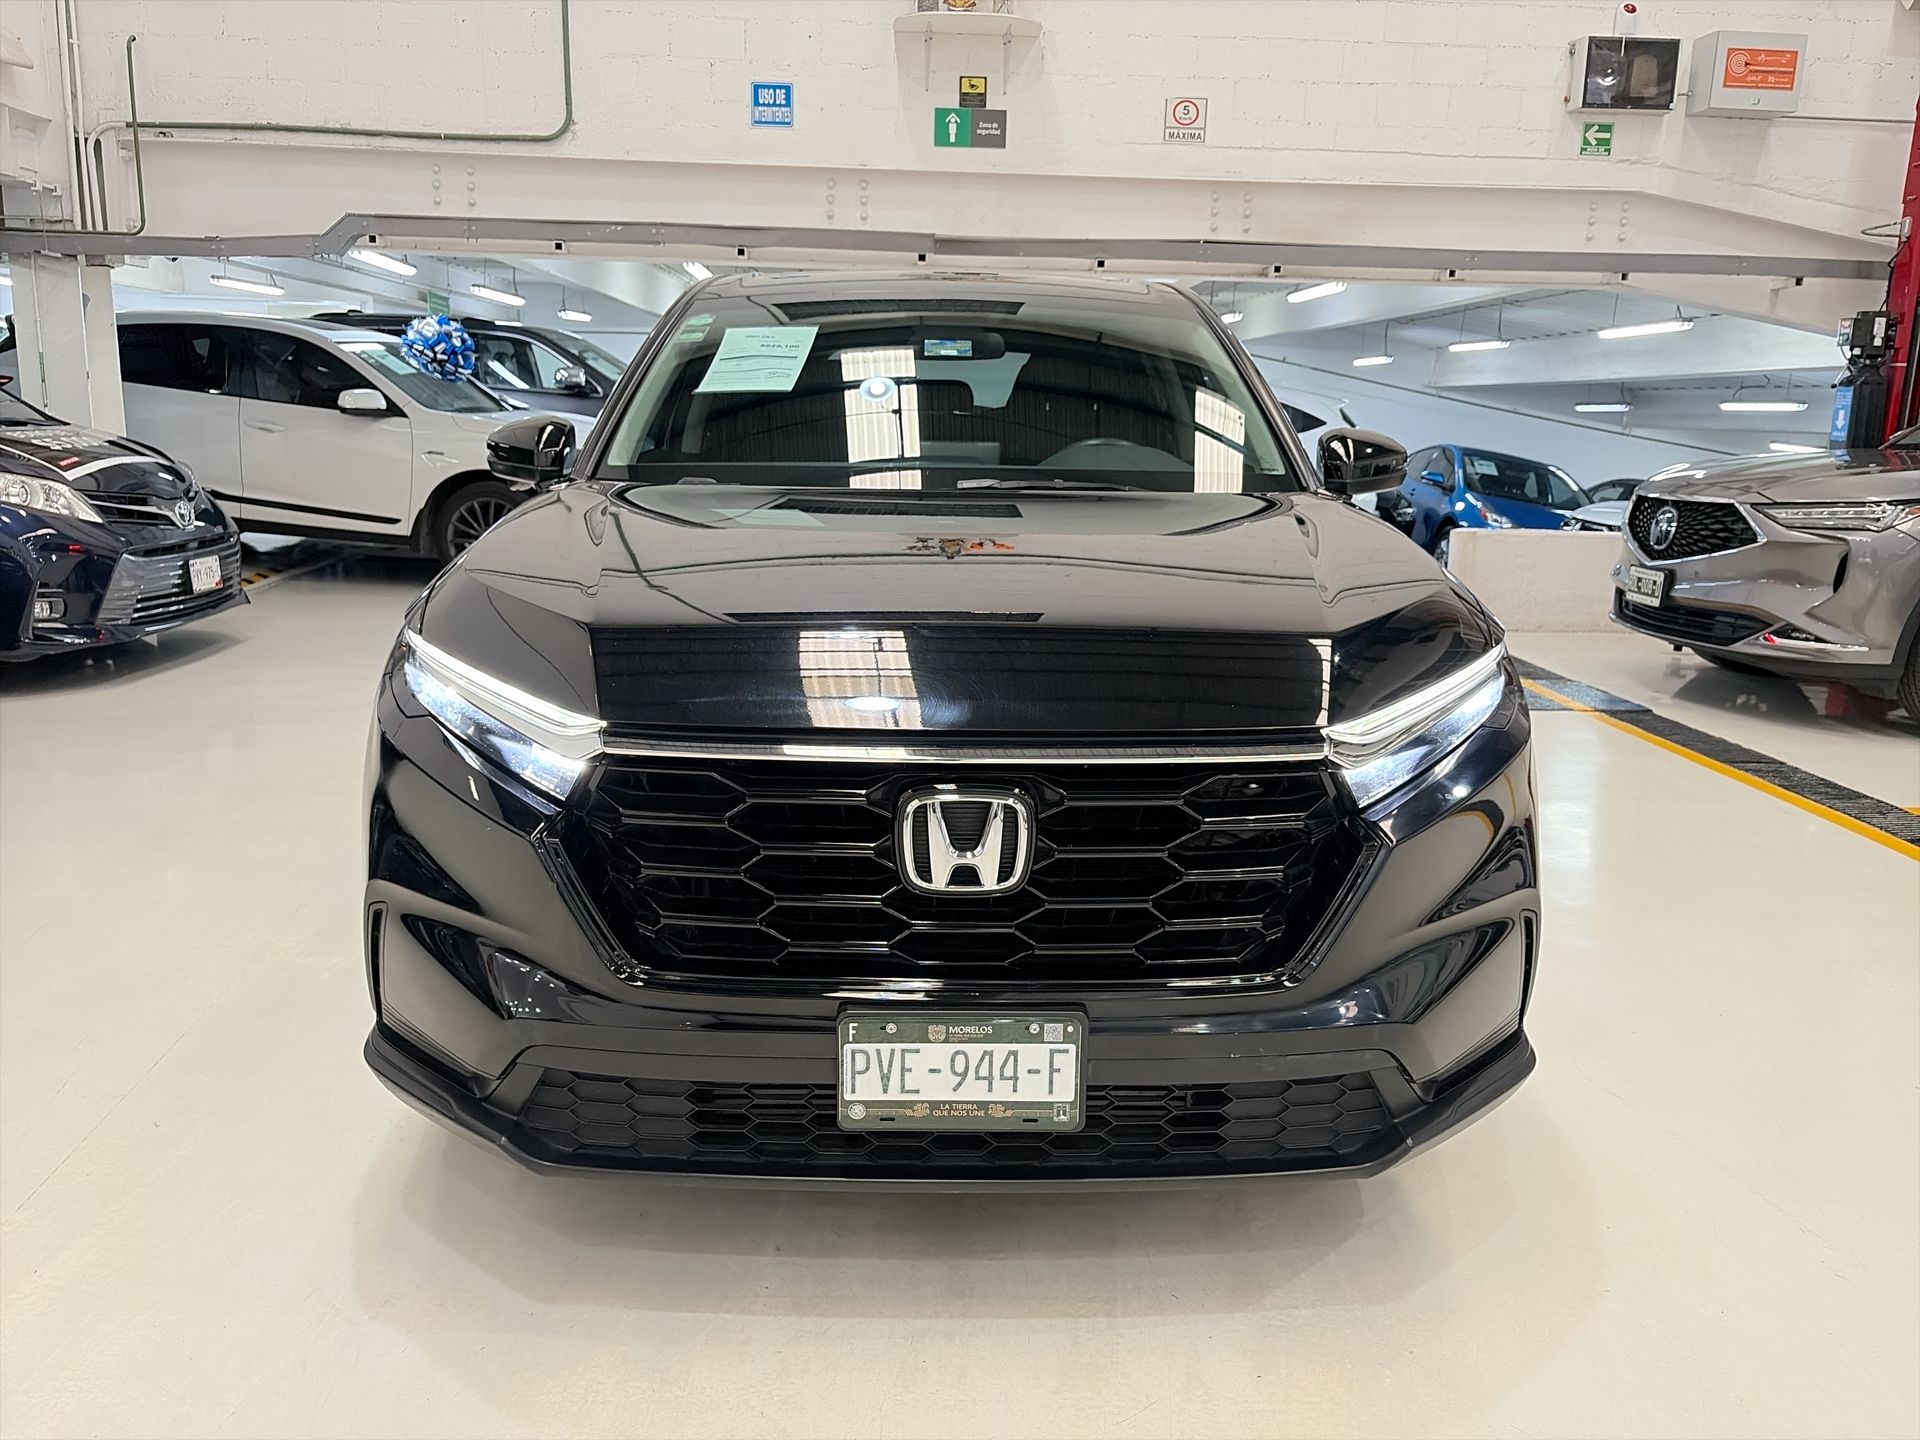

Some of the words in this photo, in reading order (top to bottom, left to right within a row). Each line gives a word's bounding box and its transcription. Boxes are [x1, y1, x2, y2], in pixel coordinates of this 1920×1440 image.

[758, 88, 774, 105] USO
[775, 89, 786, 105] DE
[1182, 105, 1190, 116] 5
[849, 1023, 858, 1041] F
[949, 1026, 993, 1034] MORELOS
[850, 1049, 1069, 1094] PVE-944-F
